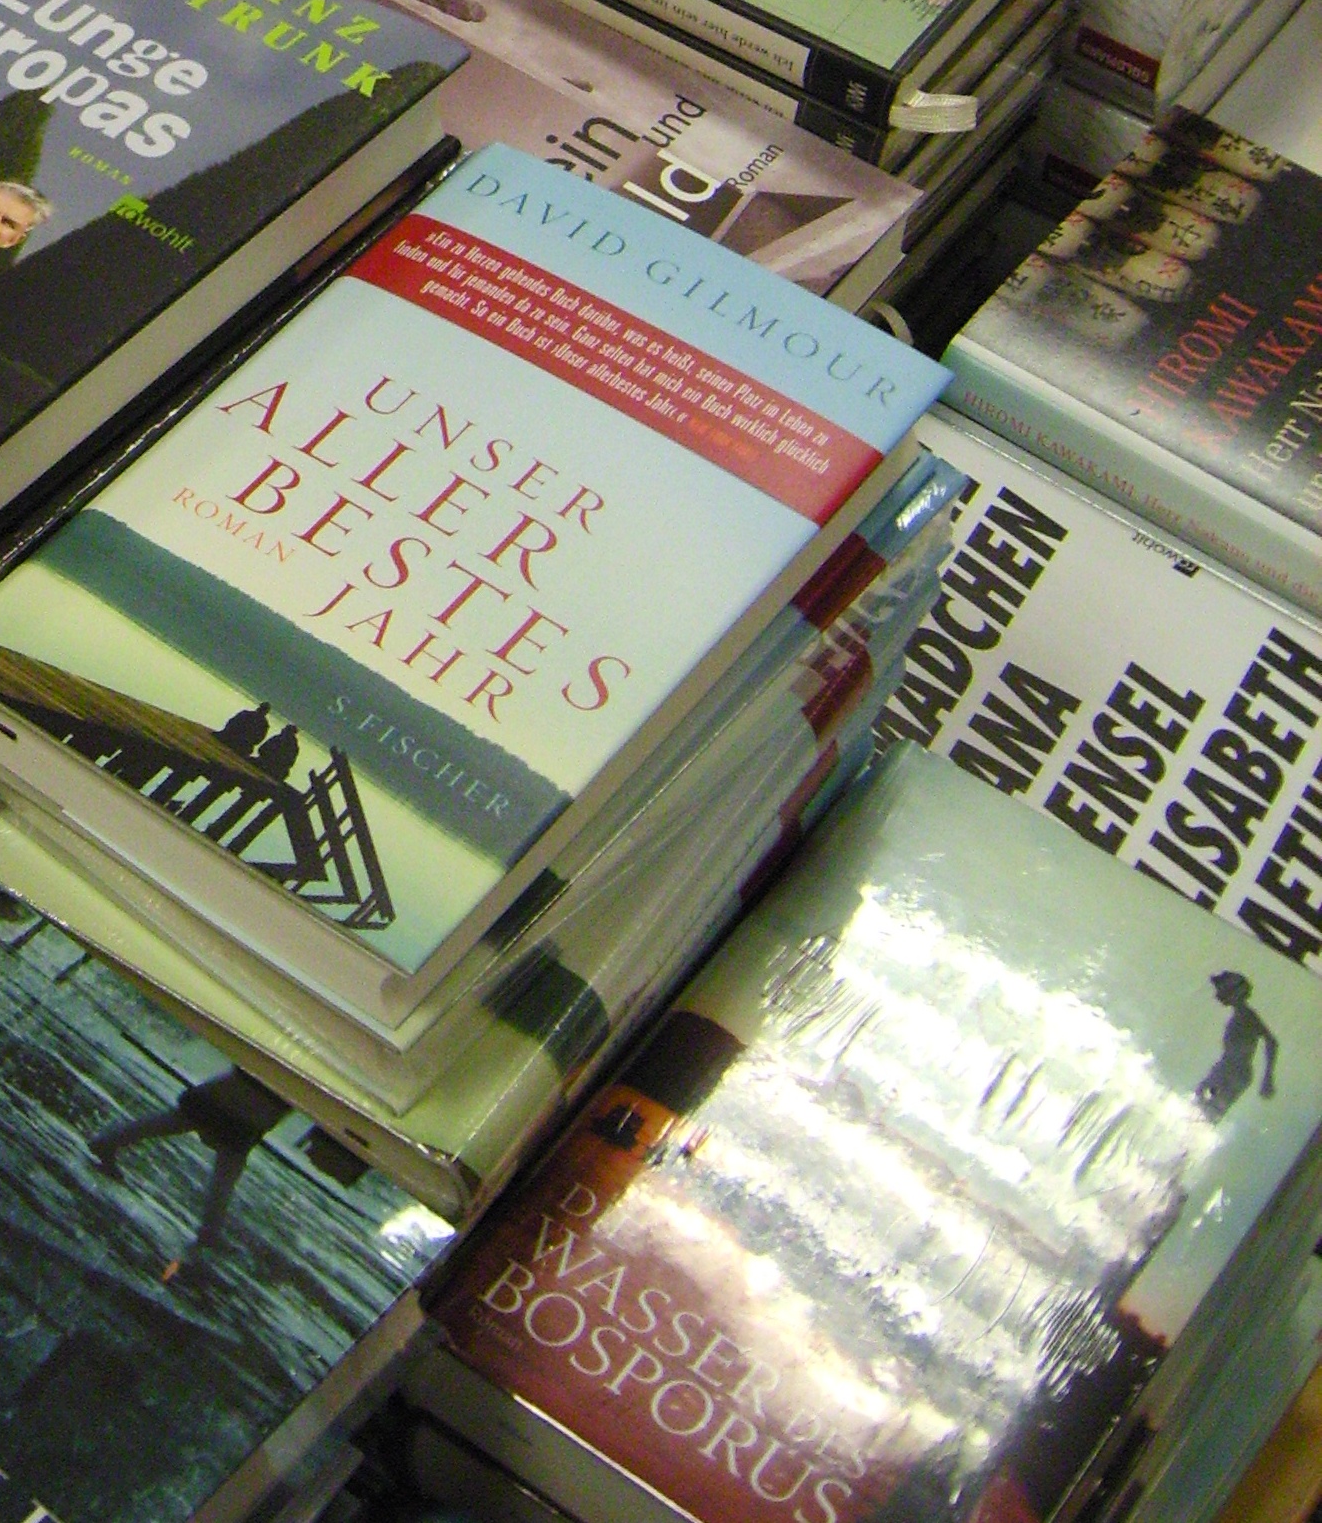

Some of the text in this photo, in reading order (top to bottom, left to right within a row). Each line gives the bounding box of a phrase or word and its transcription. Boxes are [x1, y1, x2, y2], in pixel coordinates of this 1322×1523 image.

[68, 145, 134, 187] ROMAN
[640, 93, 708, 148] und
[726, 141, 786, 195] Roman
[465, 169, 628, 260] DAVID
[645, 256, 902, 408] GILMOUR
[586, 358, 647, 403] allerbestes
[778, 407, 815, 437] Leben
[962, 390, 1033, 438] HIROMI
[1125, 290, 1259, 423] HIROMI
[216, 378, 562, 591] ALLER
[364, 375, 609, 535] UNSER
[773, 435, 833, 476] glücklich
[172, 486, 298, 566] ROMAN
[228, 453, 635, 714] BESTES
[305, 579, 520, 724] JAHR
[328, 694, 510, 823] S. FISCHER
[948, 661, 1083, 797] ANA
[1044, 660, 1207, 856] ENSEL
[531, 1214, 780, 1419] WASSER
[480, 1257, 854, 1523] BOSPORUS
